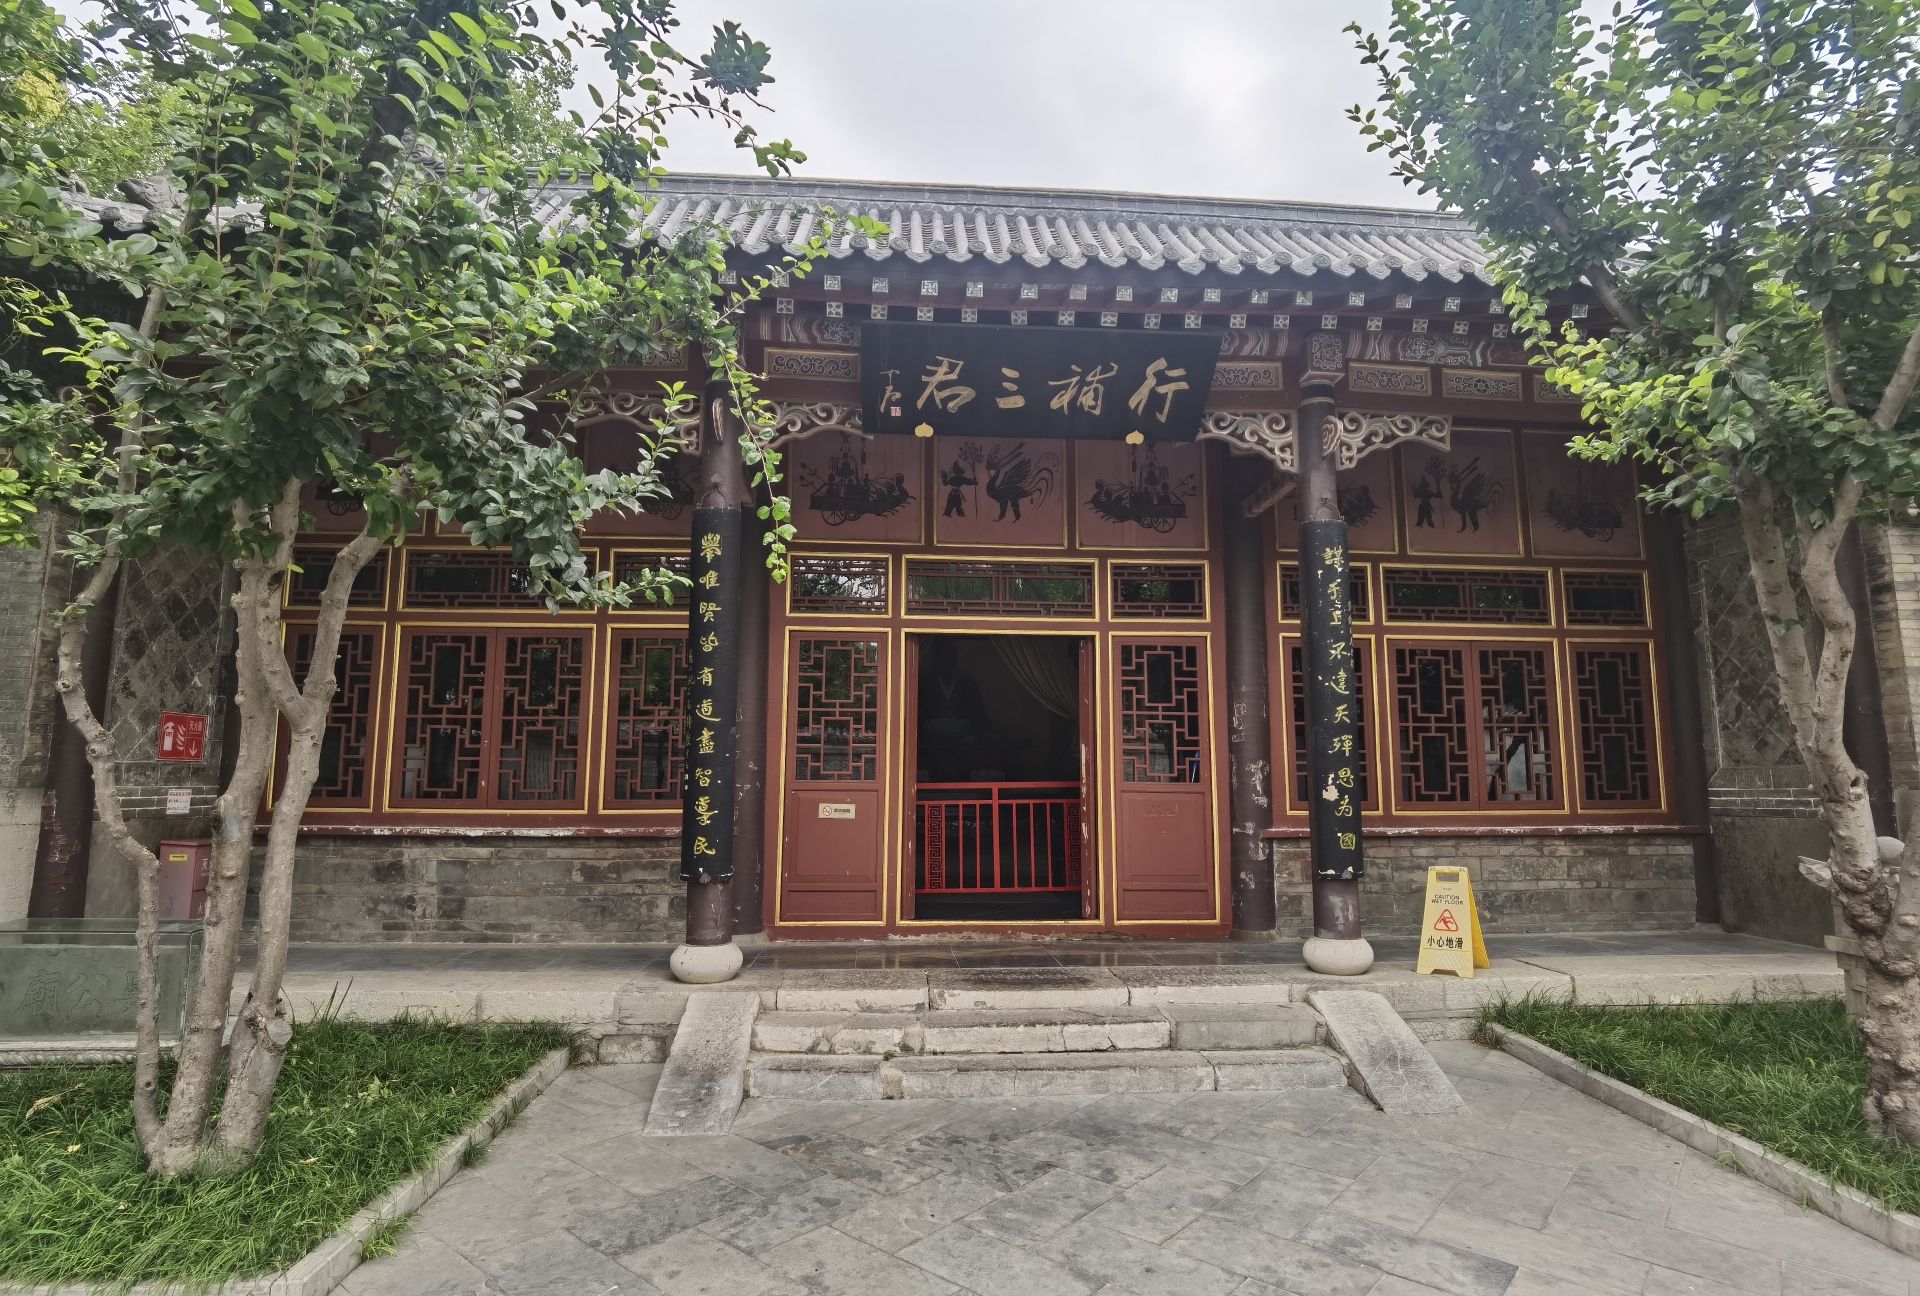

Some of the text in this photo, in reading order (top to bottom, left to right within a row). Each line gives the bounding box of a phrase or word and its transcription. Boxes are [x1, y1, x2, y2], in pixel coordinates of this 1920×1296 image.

[189, 721, 203, 731] 灭火器
[1427, 935, 1463, 949] 小心地滑
